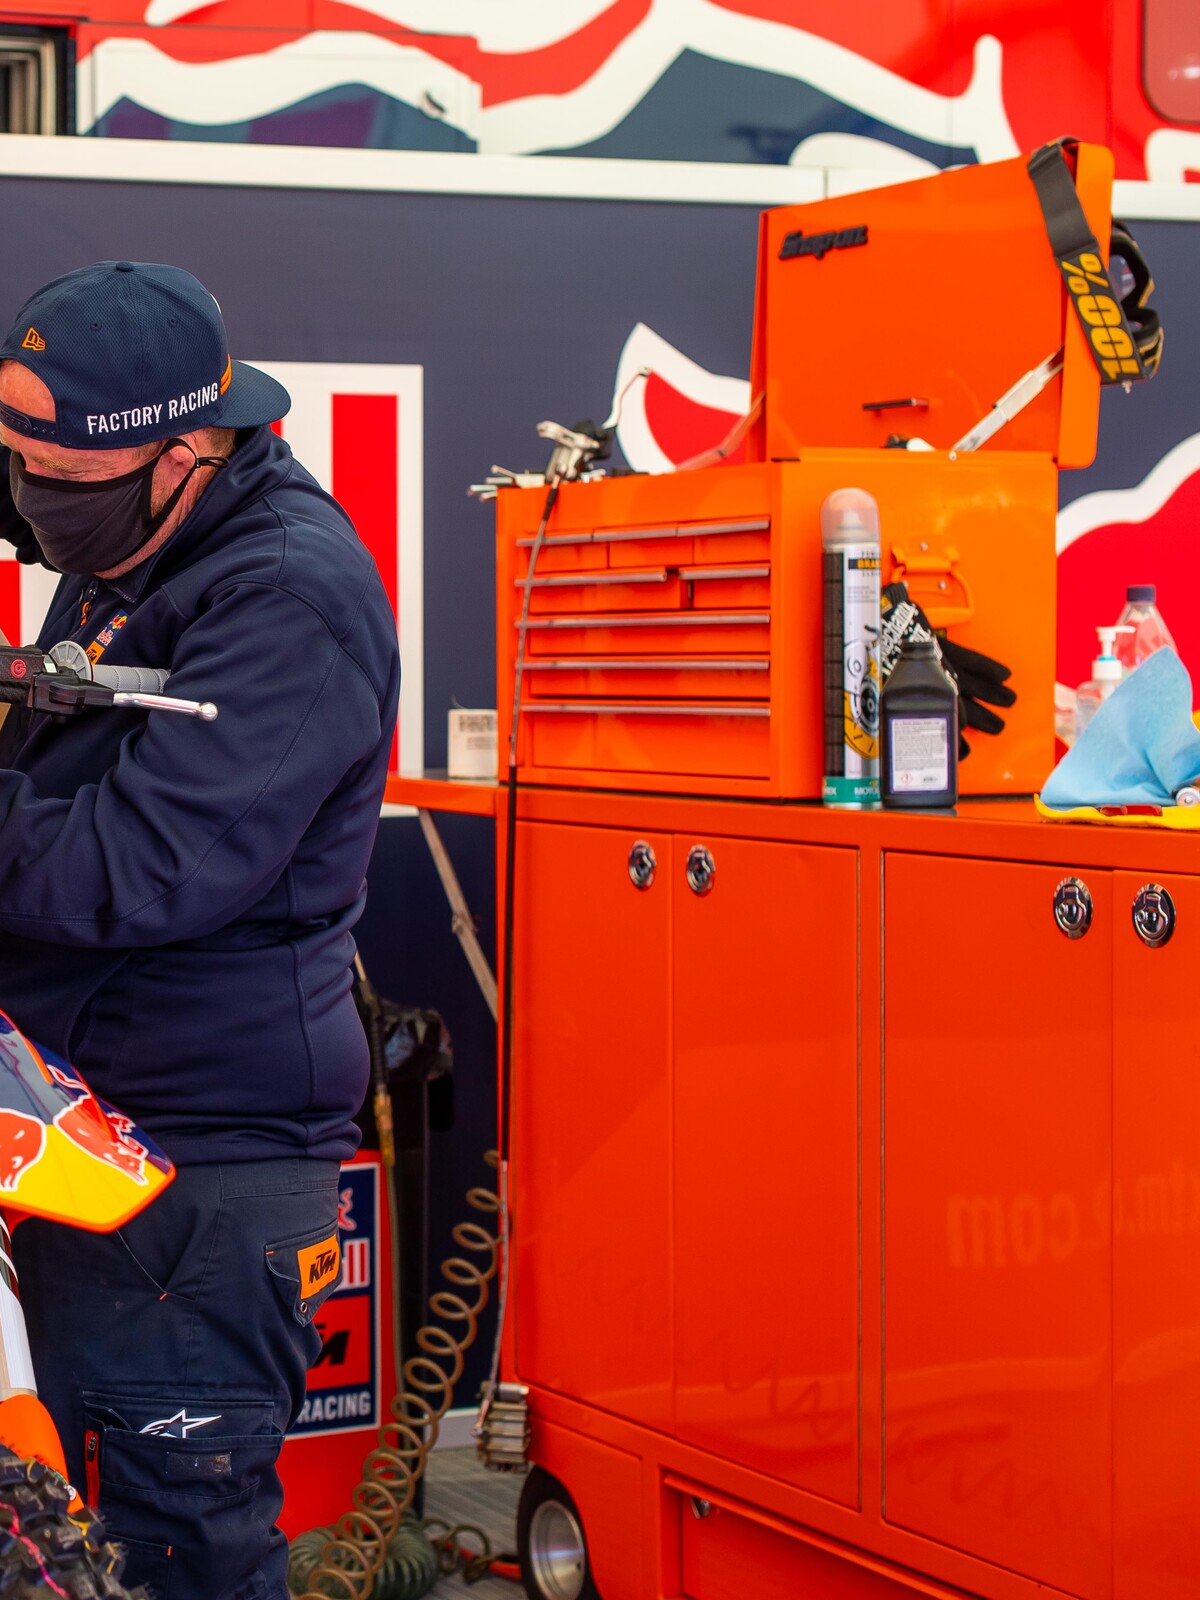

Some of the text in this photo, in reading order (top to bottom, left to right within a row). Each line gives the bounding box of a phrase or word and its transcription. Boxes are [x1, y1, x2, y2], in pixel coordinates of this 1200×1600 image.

[1061, 253, 1140, 380] 100%
[86, 382, 219, 435] FACTORY RACING
[308, 1248, 338, 1285] KTM
[298, 1391, 372, 1425] RACING
